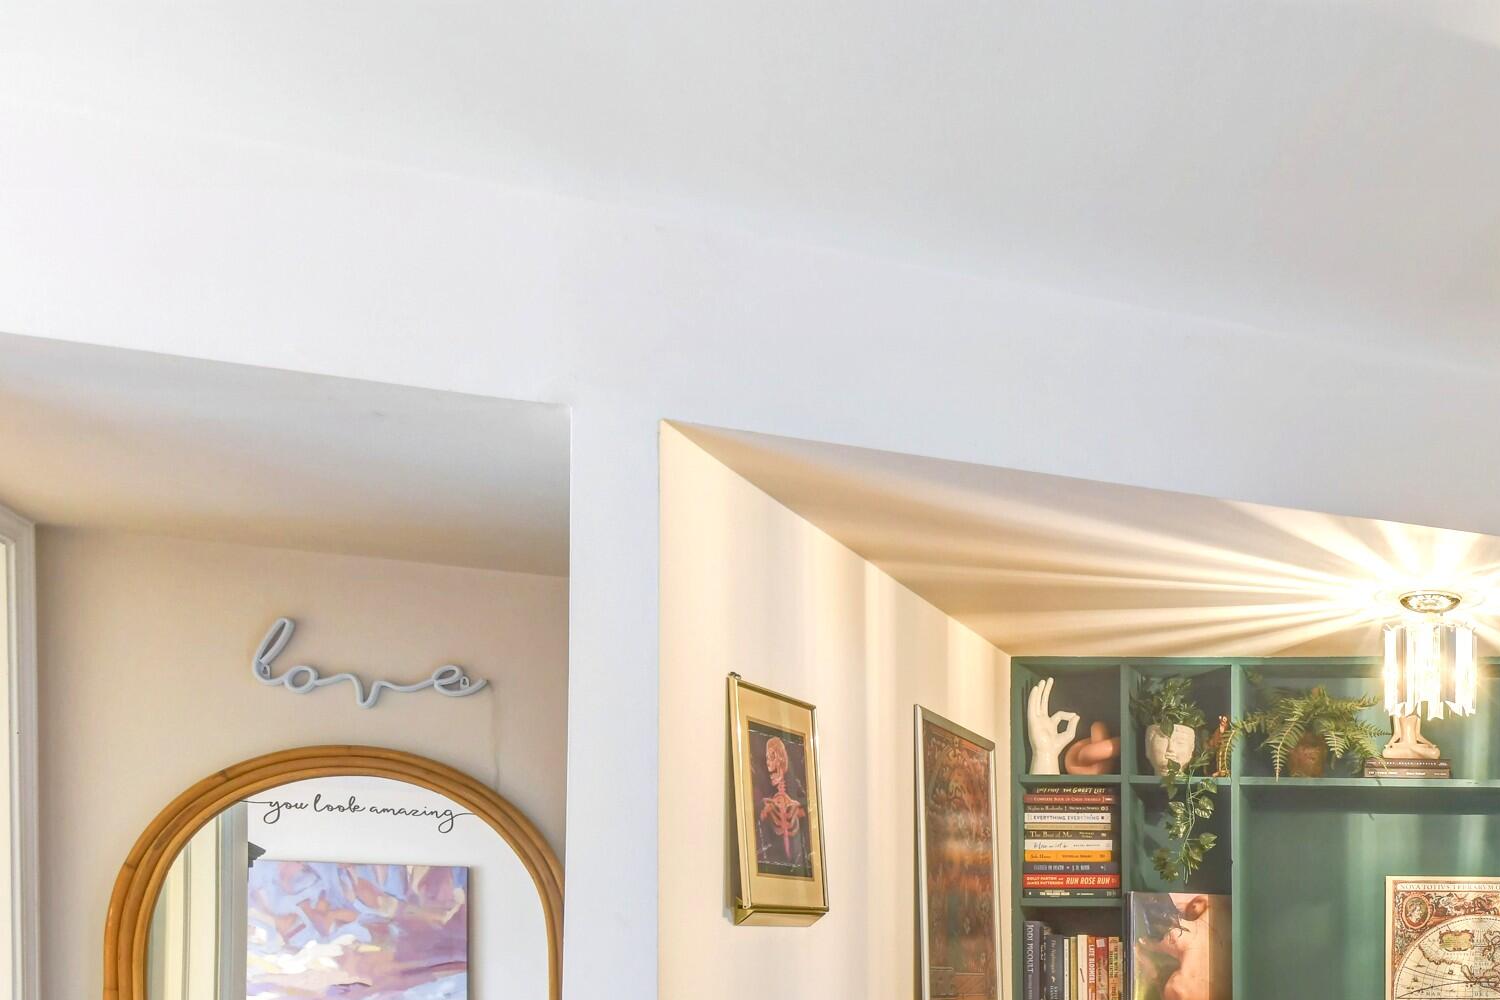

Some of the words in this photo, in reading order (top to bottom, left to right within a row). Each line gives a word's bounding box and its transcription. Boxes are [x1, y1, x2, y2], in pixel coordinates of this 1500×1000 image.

[252, 616, 490, 708] love
[263, 798, 310, 825] you
[313, 793, 367, 814] look
[368, 804, 462, 834] amazing
[1065, 877, 1079, 885] RUN
[1080, 877, 1096, 885] ROSE
[1097, 877, 1111, 885] RUN
[1026, 924, 1034, 941] JODI
